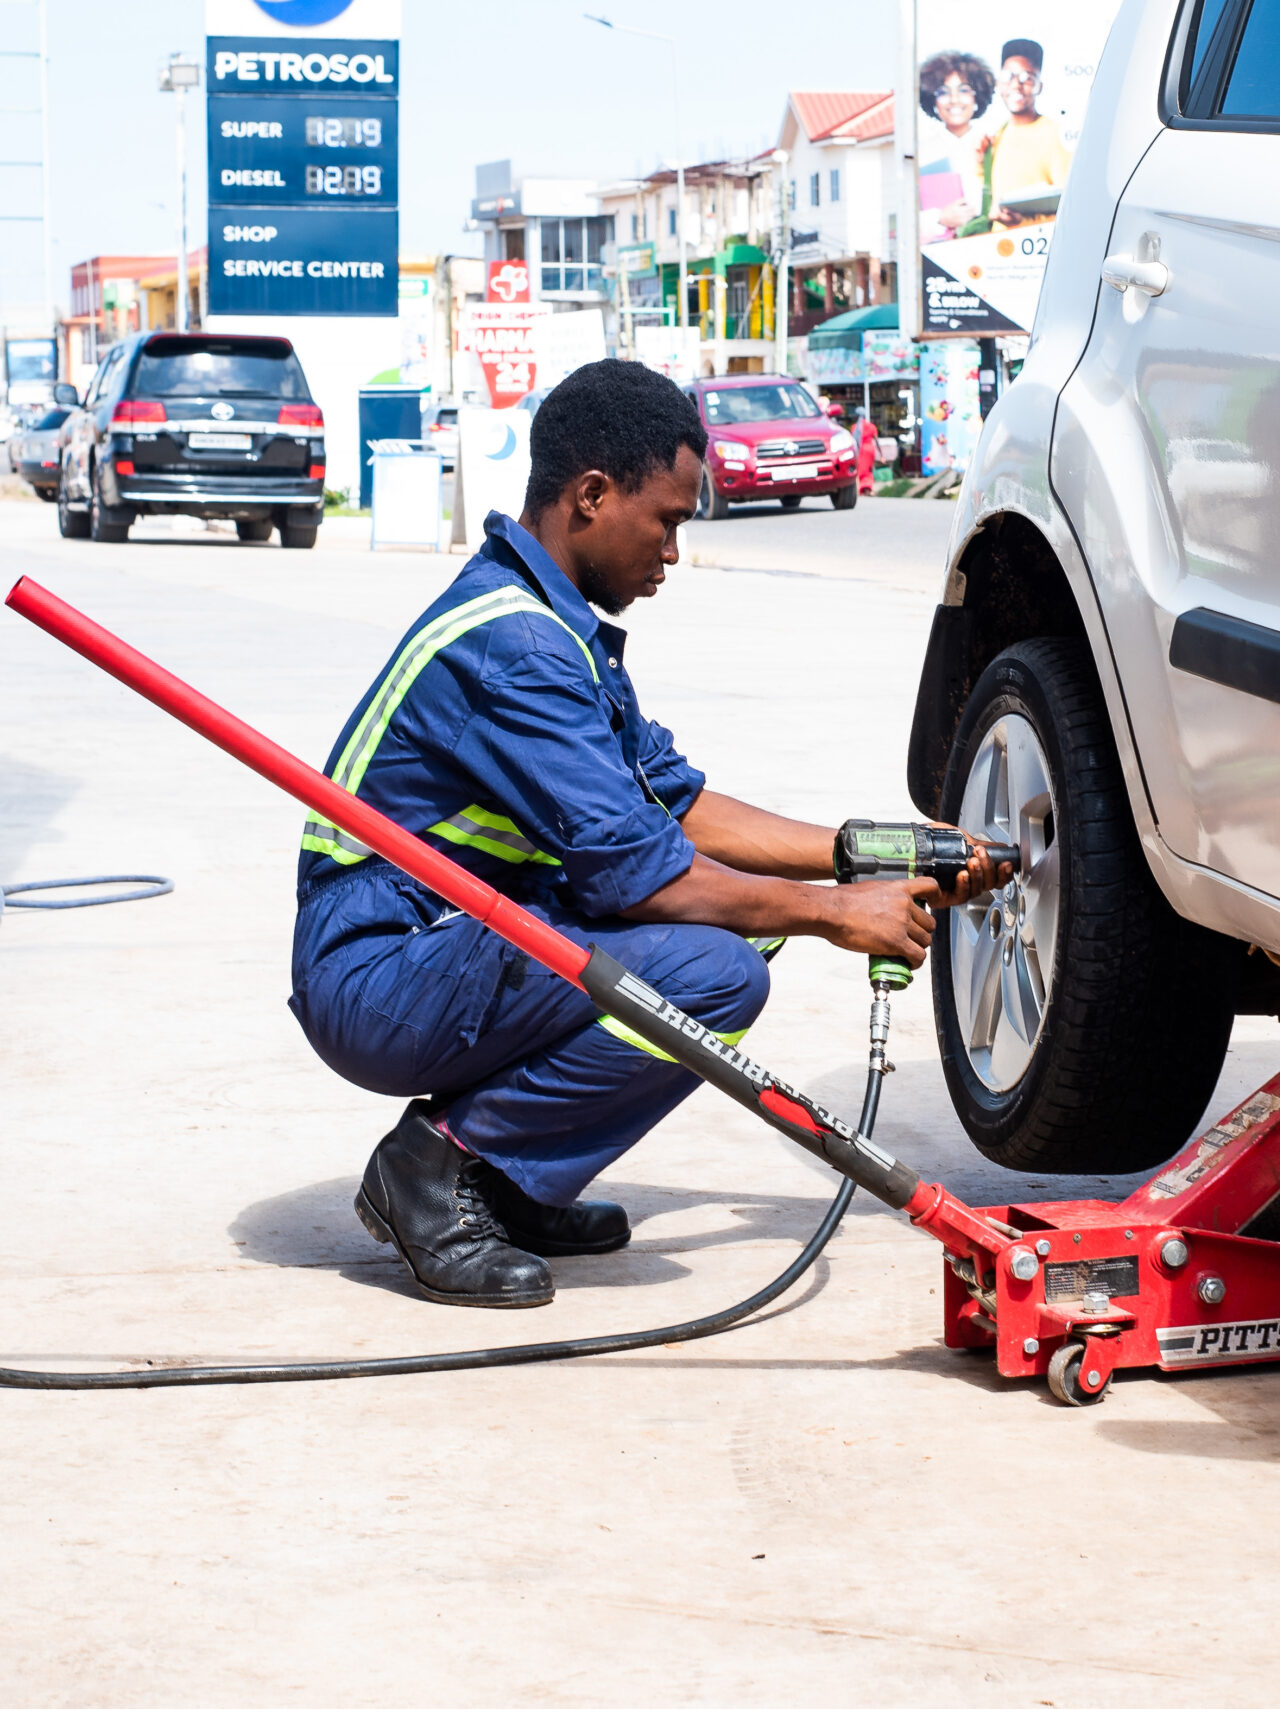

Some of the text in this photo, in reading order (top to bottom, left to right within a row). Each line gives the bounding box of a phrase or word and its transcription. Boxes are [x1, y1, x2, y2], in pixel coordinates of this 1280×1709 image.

[214, 51, 394, 83] PETROSOL
[221, 118, 382, 148] SUPER 12.19
[221, 165, 382, 195] DIESEL 12.19
[223, 225, 278, 243] SHOP
[1021, 237, 1048, 255] 02
[223, 260, 385, 278] SERVICE CENTER
[496, 362, 531, 383] 24
